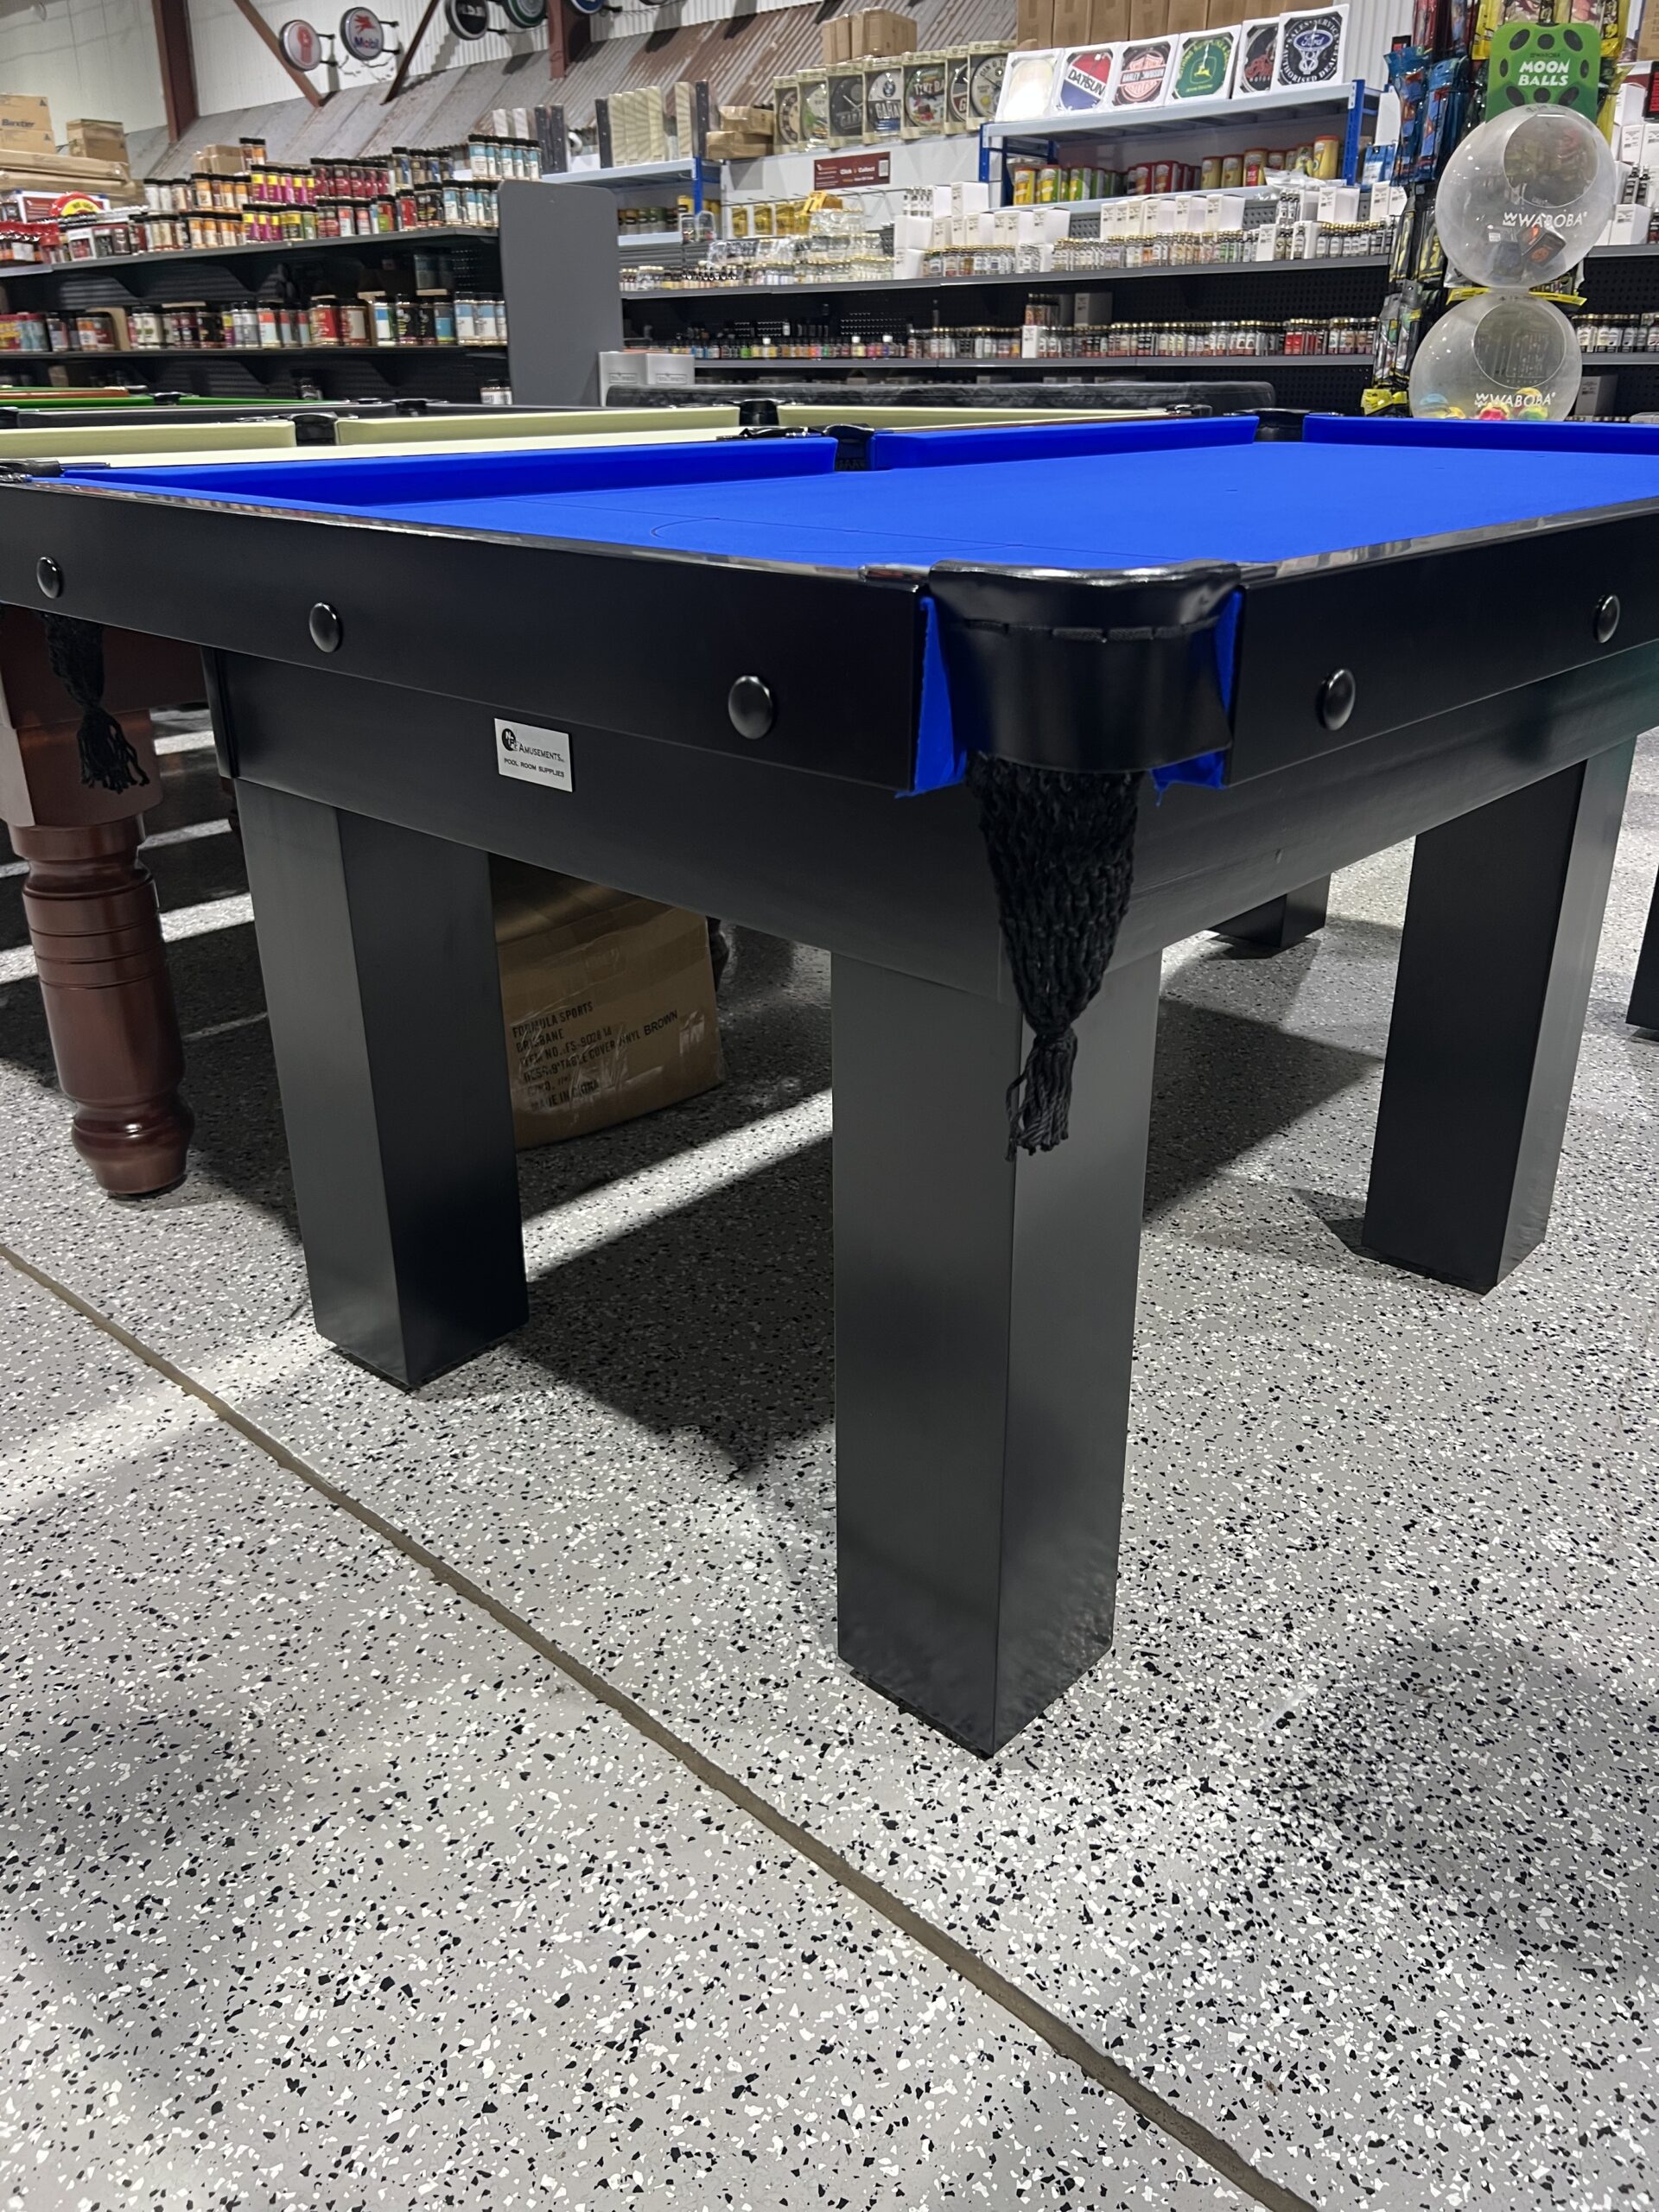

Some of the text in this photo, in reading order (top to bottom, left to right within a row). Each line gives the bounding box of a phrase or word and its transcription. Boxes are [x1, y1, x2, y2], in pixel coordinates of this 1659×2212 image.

[1518, 58, 1570, 73] MOON
[1068, 69, 1106, 95] DATSUN
[1517, 75, 1568, 86] BALLS
[504, 758, 565, 778] POOL ROOM SUPPLIES
[512, 1001, 594, 1038] FORMULA SPORTS
[588, 1039, 615, 1060] COVER
[643, 1008, 678, 1036] BROWN
